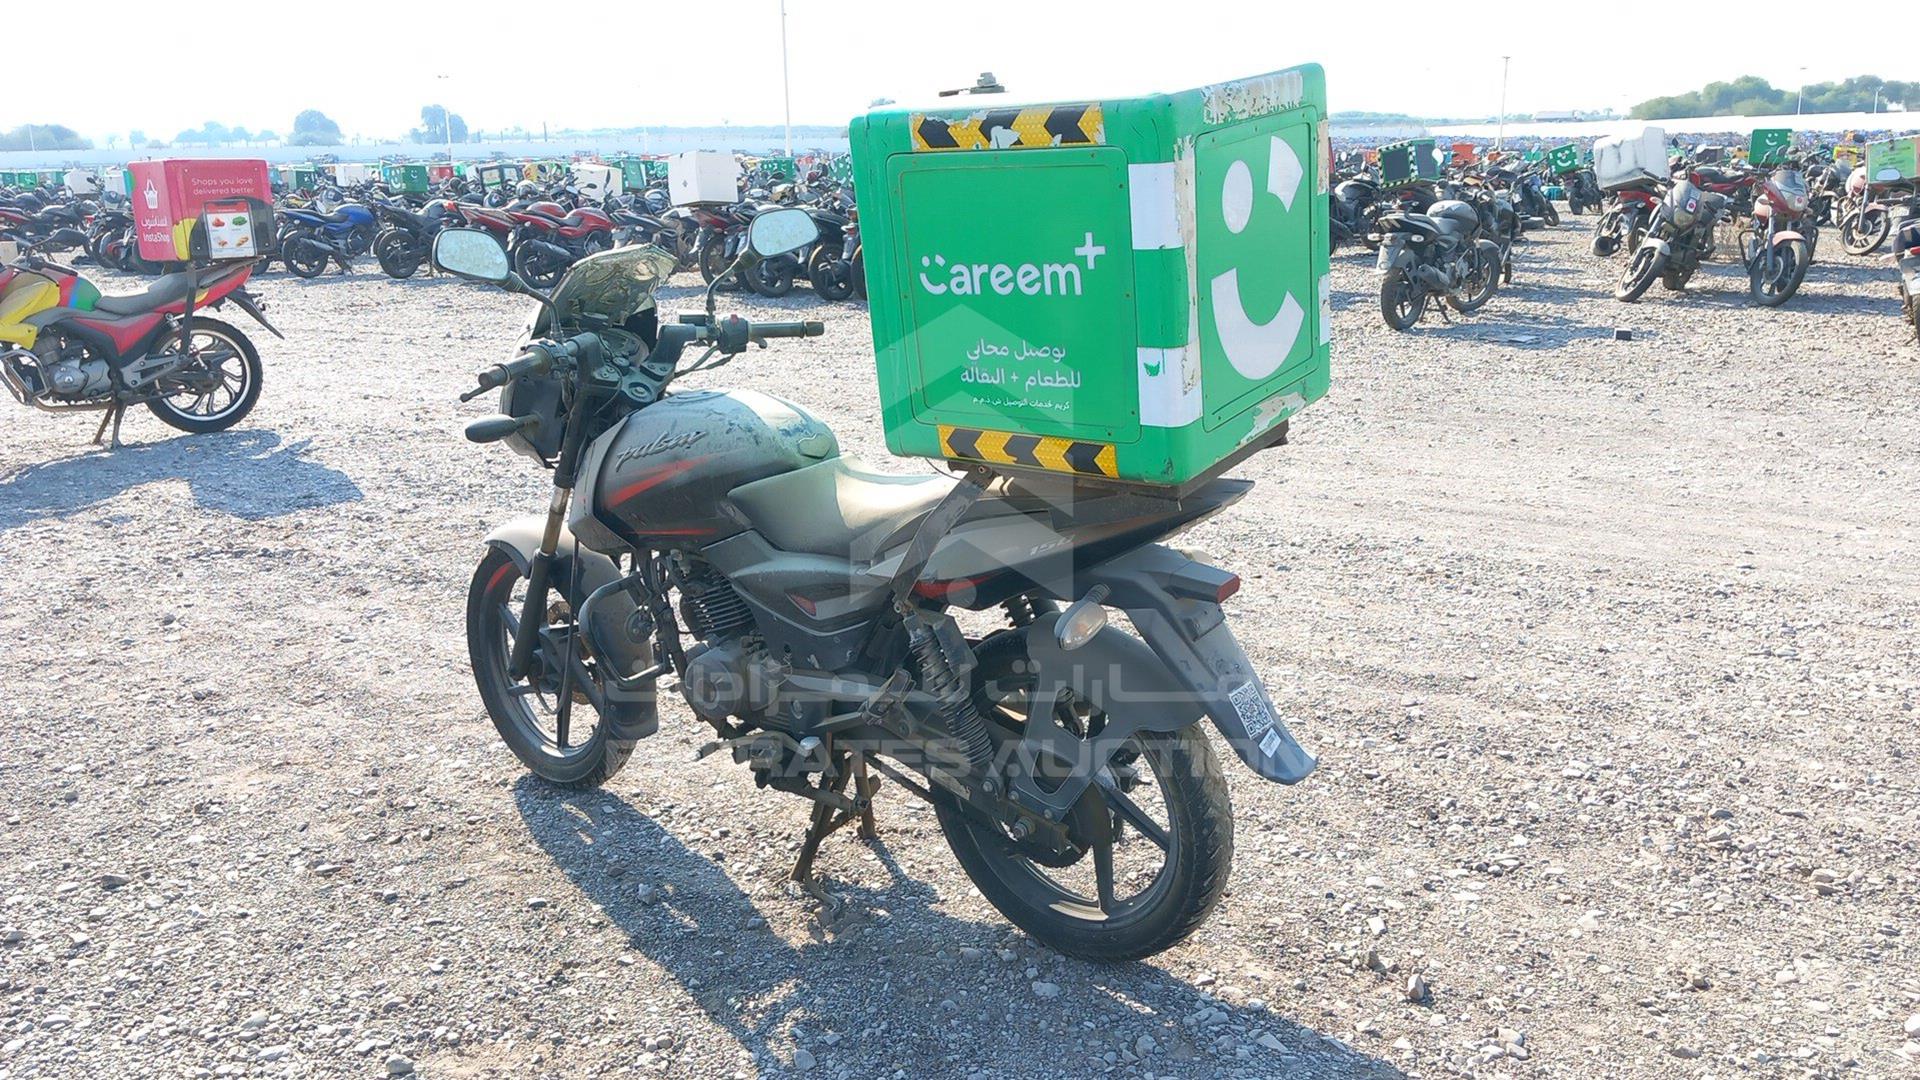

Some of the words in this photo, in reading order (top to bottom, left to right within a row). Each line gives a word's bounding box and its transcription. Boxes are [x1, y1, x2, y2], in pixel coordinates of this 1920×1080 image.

[191, 177, 217, 186] Shops
[220, 178, 234, 186] you
[236, 176, 253, 185] love
[193, 186, 229, 196] delivered
[231, 185, 254, 194] better
[144, 231, 170, 244] InstaShop
